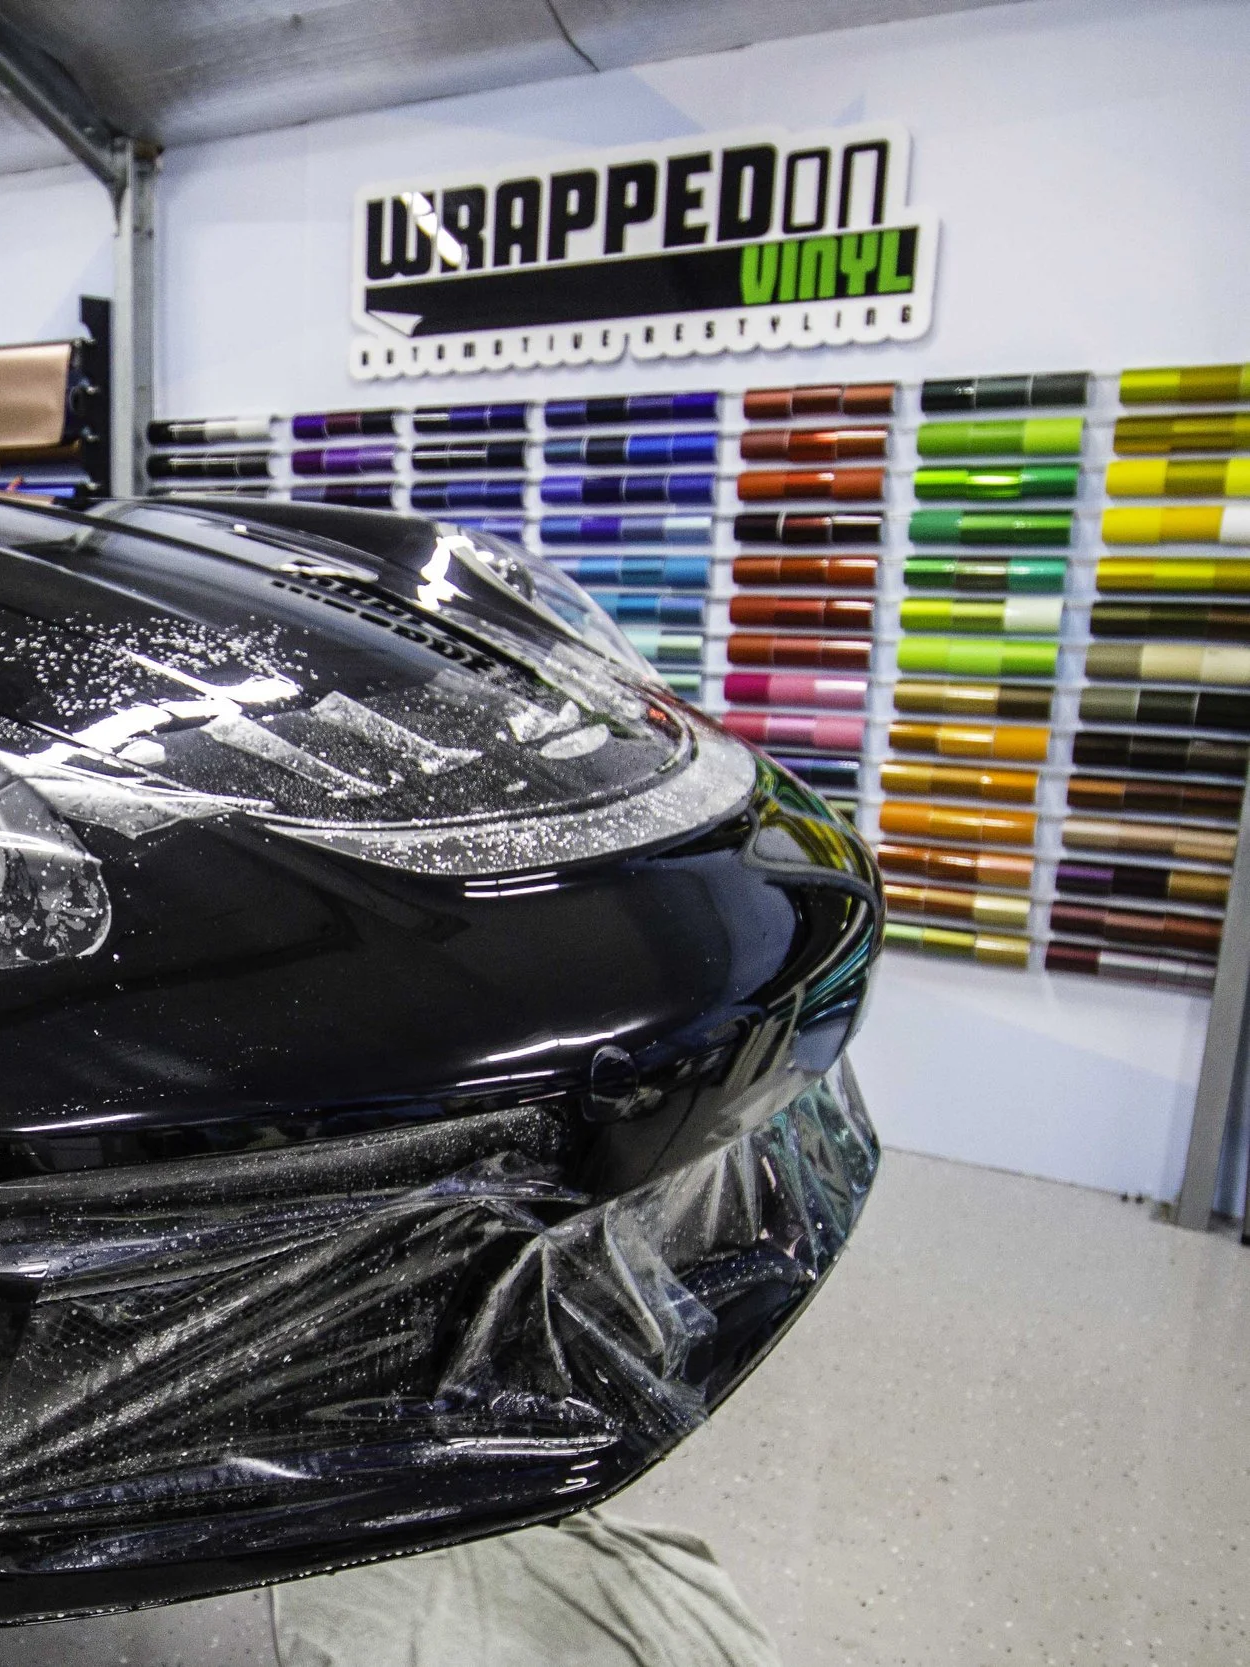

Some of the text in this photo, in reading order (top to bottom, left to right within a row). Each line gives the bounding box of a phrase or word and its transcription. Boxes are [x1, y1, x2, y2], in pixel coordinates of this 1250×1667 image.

[366, 142, 777, 280] WRAPPED
[740, 230, 913, 306] VINYL
[361, 303, 913, 367] AUTOMOTIVE RESTYLING
